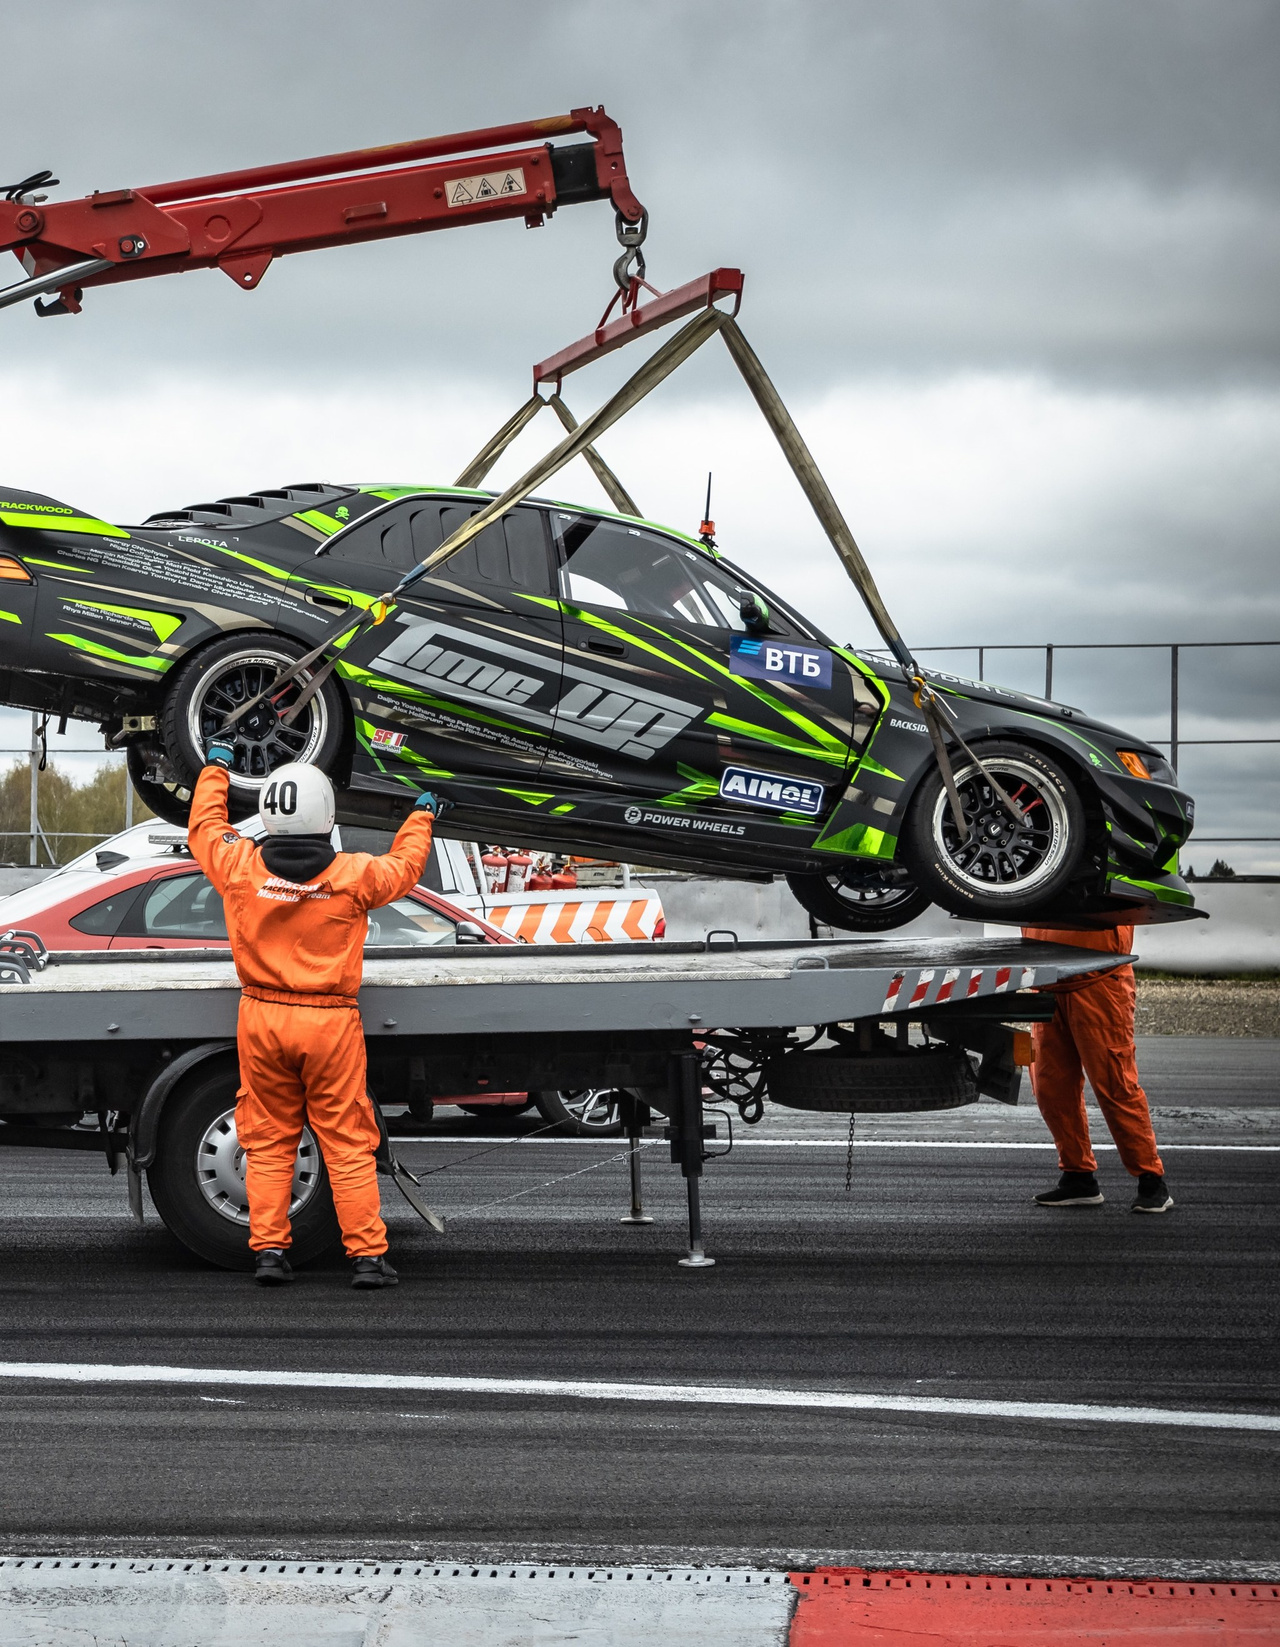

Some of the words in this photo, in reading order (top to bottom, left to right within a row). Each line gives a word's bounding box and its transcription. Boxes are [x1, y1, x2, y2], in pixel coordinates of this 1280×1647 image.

[103, 537, 129, 547] Georgy
[131, 545, 168, 557] Chivchyan
[109, 543, 128, 551] Nigel
[178, 536, 228, 548] LEPOTA
[57, 550, 85, 559] Charles
[150, 572, 176, 582] Tommy
[178, 579, 209, 592] Lemaire
[72, 548, 101, 558] Stephan
[103, 555, 140, 568] Papadakis
[165, 571, 186, 579] Evans
[190, 578, 212, 586] Damir
[90, 548, 115, 557] Marcin
[190, 573, 222, 584] Imamura
[226, 583, 261, 595] Nobuteru
[183, 565, 201, 574] Field
[203, 572, 238, 584] Katsuhiro
[63, 605, 81, 613] Rhys
[82, 610, 103, 618] Millen
[105, 616, 131, 625] Tanner
[75, 603, 98, 611] Martin
[100, 610, 133, 620] Richards
[370, 612, 546, 705] Time
[765, 647, 821, 677] ВТБ
[377, 694, 399, 704] Daijiro
[400, 702, 436, 716] Yoshihara
[457, 720, 480, 730] Peters
[483, 727, 510, 741] Fredric
[890, 718, 930, 733] BACKSID
[392, 705, 408, 713] Alex
[446, 722, 464, 730] Juha
[501, 738, 527, 750] Michael
[547, 754, 574, 765] Georgy
[576, 763, 613, 779] Chivchyan
[1028, 753, 1066, 794] TRI-ACE
[264, 781, 298, 815] 40
[724, 774, 816, 809] AIMOL
[643, 813, 691, 828] POWER
[693, 820, 746, 836] WHEELS
[256, 889, 300, 902] Marshals
[261, 886, 301, 895] RACEWAY
